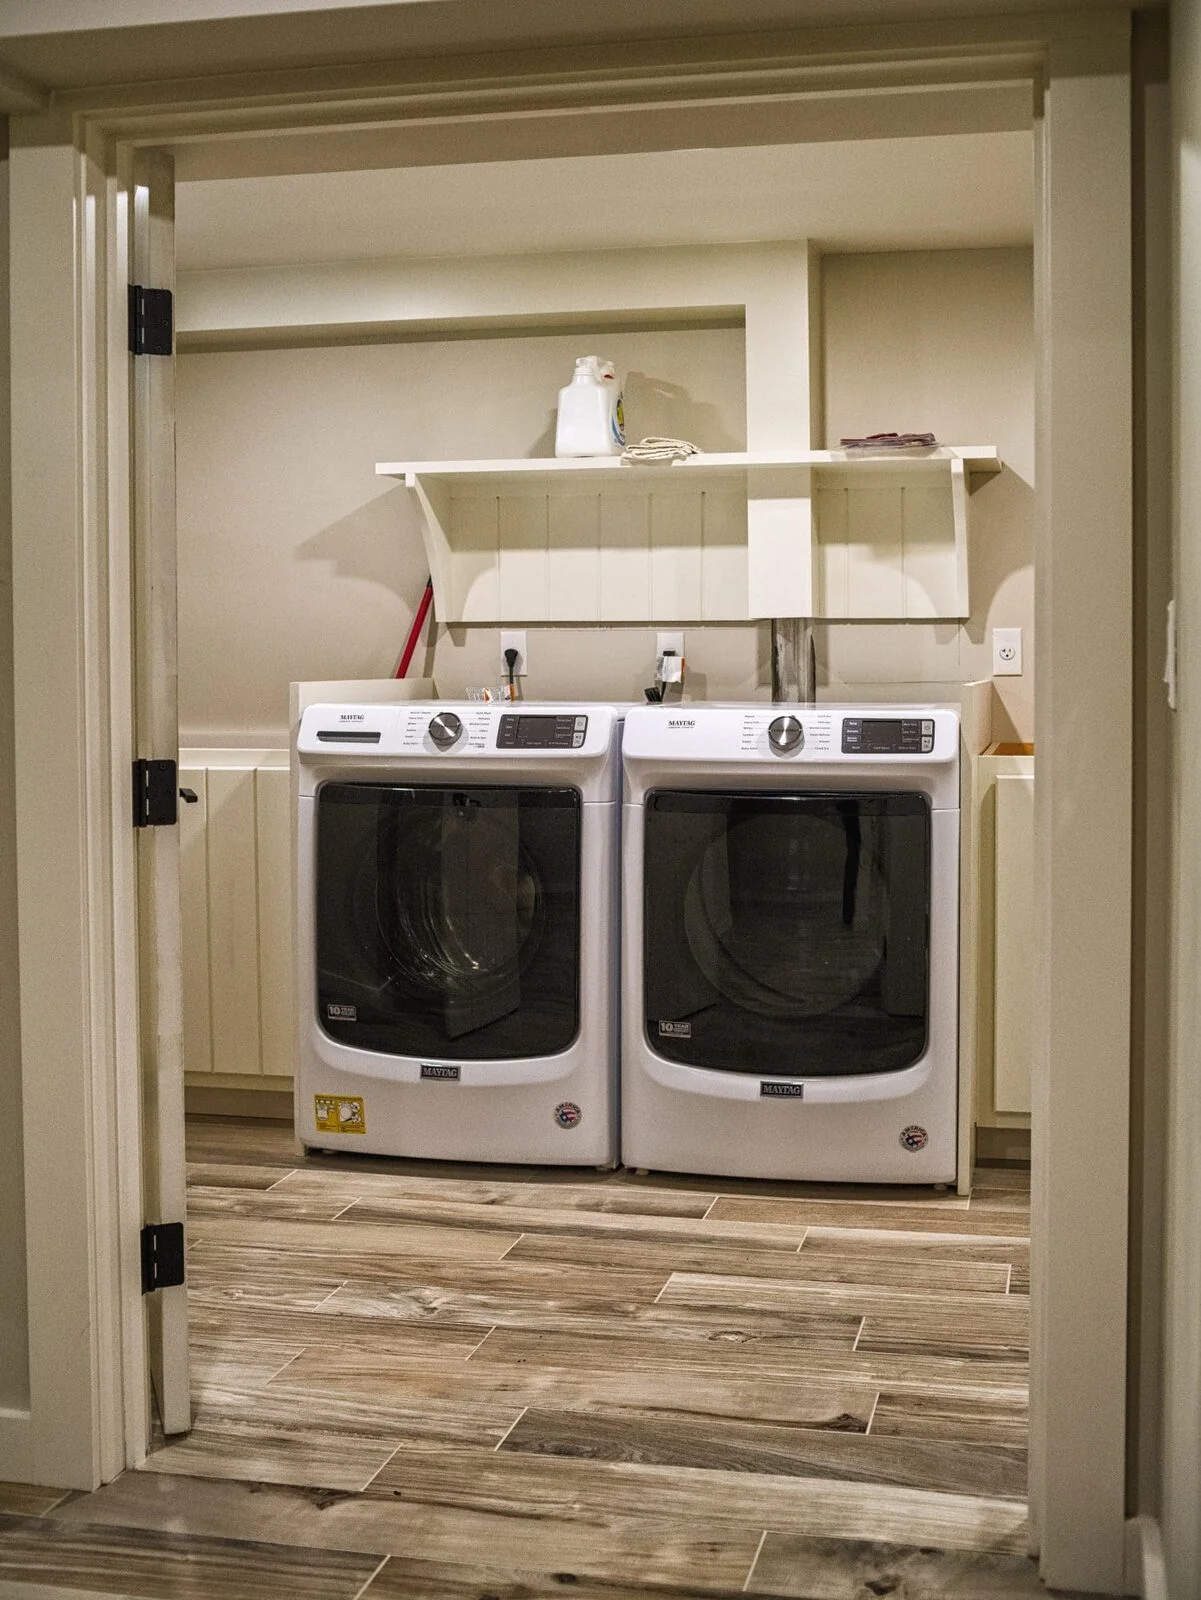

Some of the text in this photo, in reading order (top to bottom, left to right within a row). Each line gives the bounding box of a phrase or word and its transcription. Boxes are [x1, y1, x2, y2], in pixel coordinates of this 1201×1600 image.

[329, 1006, 341, 1016] 10
[660, 1022, 673, 1032] 10
[422, 1067, 458, 1078] MAYTAG
[763, 1084, 801, 1095] MAYTAG
